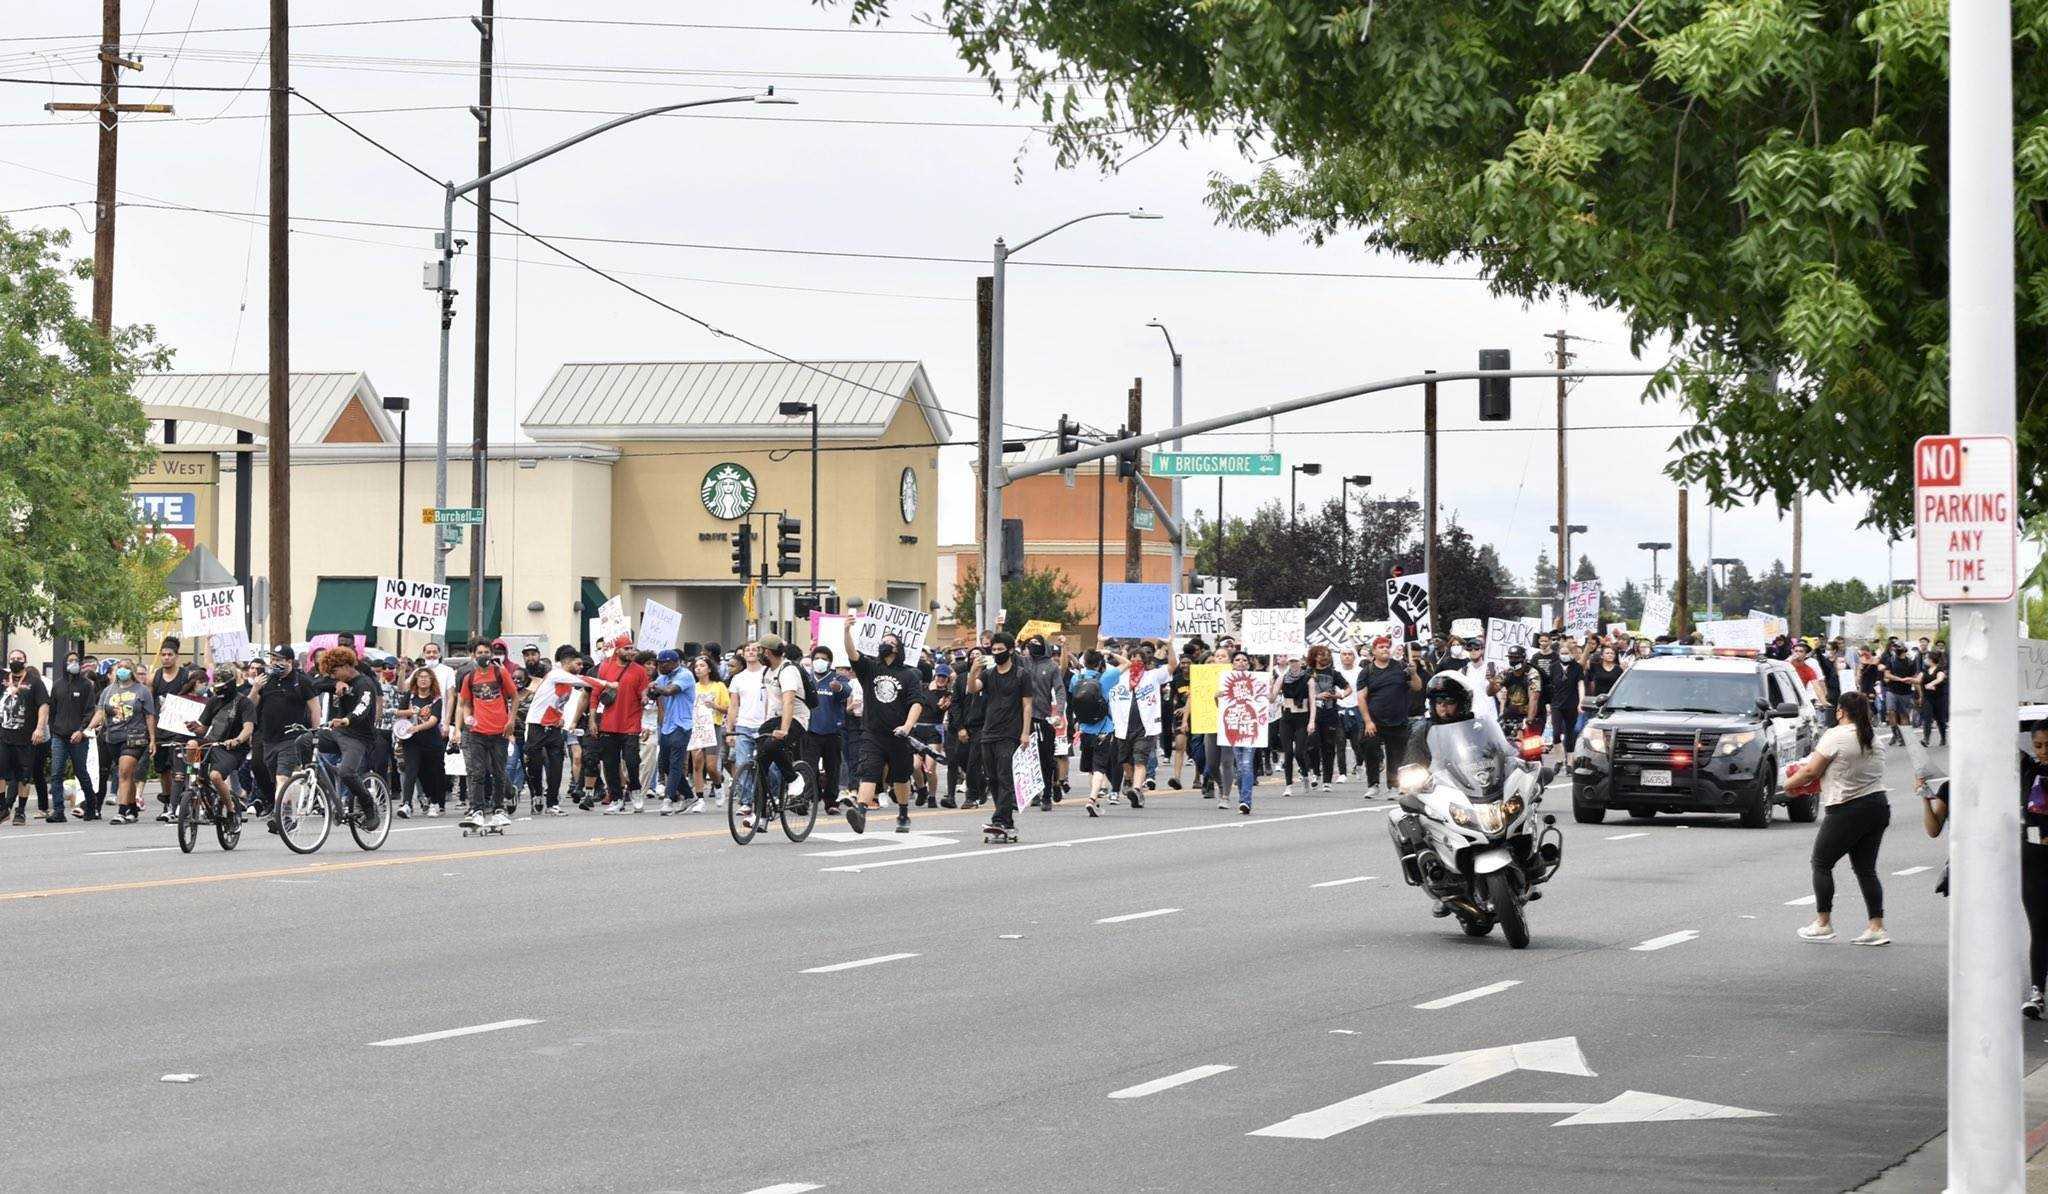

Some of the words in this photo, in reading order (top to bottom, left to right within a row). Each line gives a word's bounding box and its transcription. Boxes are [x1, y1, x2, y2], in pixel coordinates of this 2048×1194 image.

[1160, 456, 1170, 472] W
[1175, 456, 1252, 472] BRIGGSMORE
[1921, 444, 1956, 481] NO
[435, 510, 472, 522] Burchell
[1925, 493, 2007, 523] PARKING
[1948, 530, 1983, 552] ANY
[1947, 559, 1986, 582] TIME
[193, 589, 235, 609] BLACK
[386, 579, 407, 597] NO
[411, 582, 449, 601] MORE
[200, 604, 231, 620] LIVES
[384, 596, 448, 617] KKKILLER
[1174, 594, 1223, 612] BLACK
[393, 612, 435, 631] COPS
[866, 602, 885, 620] NO
[885, 606, 929, 633] JUSTICE
[1175, 617, 1227, 634] MATTER
[859, 623, 877, 639] NO
[1491, 620, 1533, 648] BLACK
